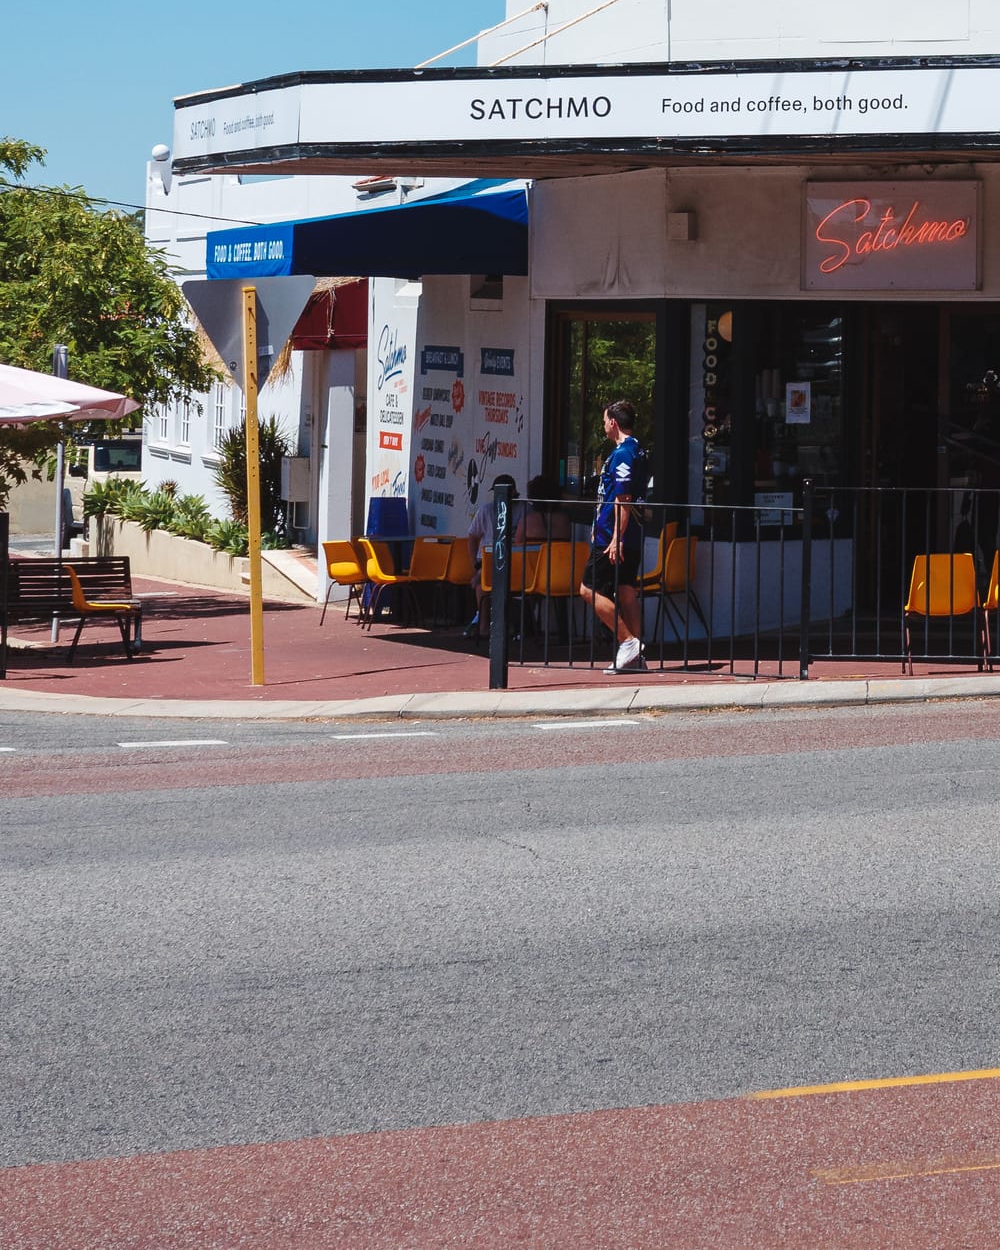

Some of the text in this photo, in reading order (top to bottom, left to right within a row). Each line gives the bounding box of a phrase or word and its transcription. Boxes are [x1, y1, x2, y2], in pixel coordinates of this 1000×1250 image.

[470, 93, 908, 120] SATCHMO Food and coffee, both good.
[190, 117, 216, 141] SATCHMO
[816, 199, 967, 273] Satchmo
[214, 244, 227, 263] FOOD
[228, 243, 232, 263] &
[253, 241, 268, 261] BOTH
[377, 324, 407, 391] Satchmo
[479, 391, 495, 406] VINTAGE
[496, 392, 516, 409] RECORDS
